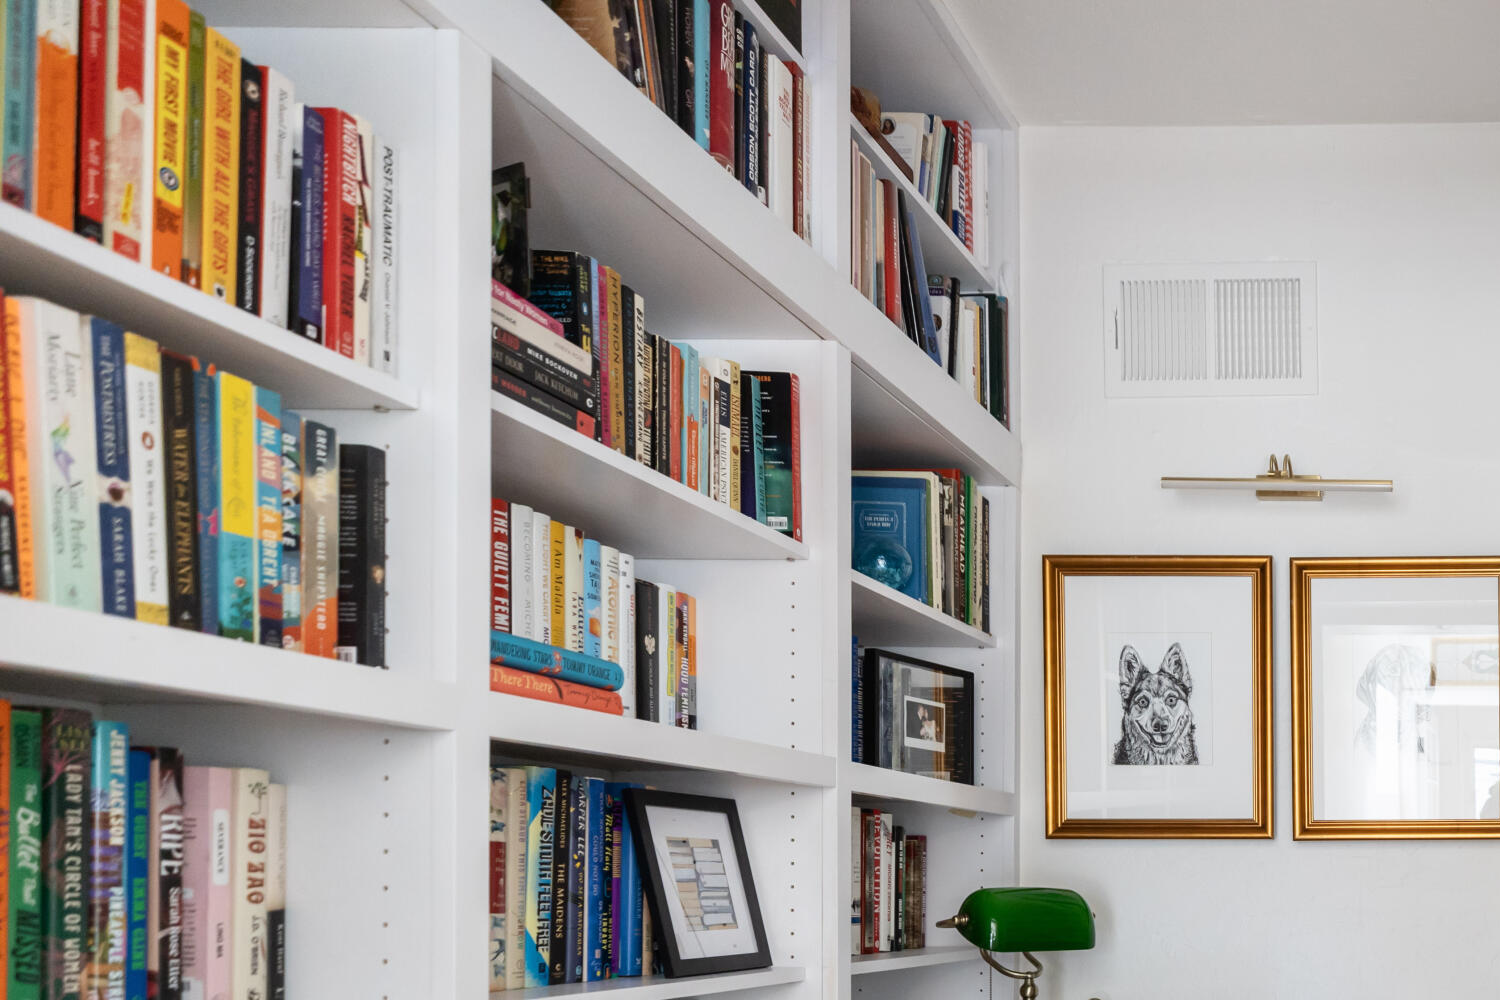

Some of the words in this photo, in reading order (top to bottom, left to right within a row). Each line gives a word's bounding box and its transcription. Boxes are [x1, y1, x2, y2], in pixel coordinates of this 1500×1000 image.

[165, 45, 180, 64] MY
[218, 56, 233, 85] THE
[164, 72, 179, 117] FIRST
[215, 88, 232, 123] GIRL
[163, 118, 178, 165] MOVIE
[215, 127, 232, 165] WITH
[342, 118, 358, 204] NIGHTBITCH
[214, 166, 230, 194] ALL
[958, 171, 966, 210] BALLS
[214, 201, 229, 225] THE
[382, 145, 393, 266] POST-TRAUMATIC
[212, 226, 230, 274] GIFTS
[342, 214, 354, 267] RACHEL
[341, 272, 354, 317] YODER
[611, 277, 620, 364] HYPERION
[527, 348, 543, 362] MIKE
[174, 428, 188, 480] WATER
[261, 422, 276, 480] INLAND
[282, 433, 296, 490] BLACK
[113, 516, 126, 563] SARAH
[282, 500, 296, 547] CAKE
[317, 515, 327, 561] MAGGIE
[494, 509, 508, 534] THE
[176, 500, 193, 594] ELEPHANTS
[495, 542, 509, 590] GUILTY
[554, 549, 562, 569] Am
[115, 570, 127, 612] BLAKE
[317, 566, 327, 630] SHIPSTEAD
[543, 575, 548, 589] WE
[554, 574, 563, 615] Malala
[523, 676, 553, 693] There
[110, 730, 125, 776] JENNY
[65, 765, 80, 802] LADY
[133, 781, 145, 809] THE
[110, 779, 125, 845] JACKSON
[541, 789, 554, 828] ZADIE
[578, 783, 586, 831] HARPER
[17, 807, 40, 876] Bullet
[65, 809, 82, 852] TAN'S
[133, 815, 145, 858] GUEST
[161, 813, 182, 875] RIPE
[540, 832, 553, 881] SMITH
[65, 857, 81, 908] CIRCLE
[133, 878, 145, 923] EMMA
[538, 883, 551, 917] FEEL
[65, 914, 80, 932] OF
[109, 887, 124, 962] PINEAPPLE
[169, 887, 179, 924] Sarah
[556, 888, 564, 938] MAIDENS
[13, 910, 40, 983] MISSED
[132, 928, 145, 970] CLINE
[169, 927, 178, 956] Rose
[217, 945, 223, 958] MA
[538, 921, 550, 952] FREE
[64, 939, 80, 993] WOMEN
